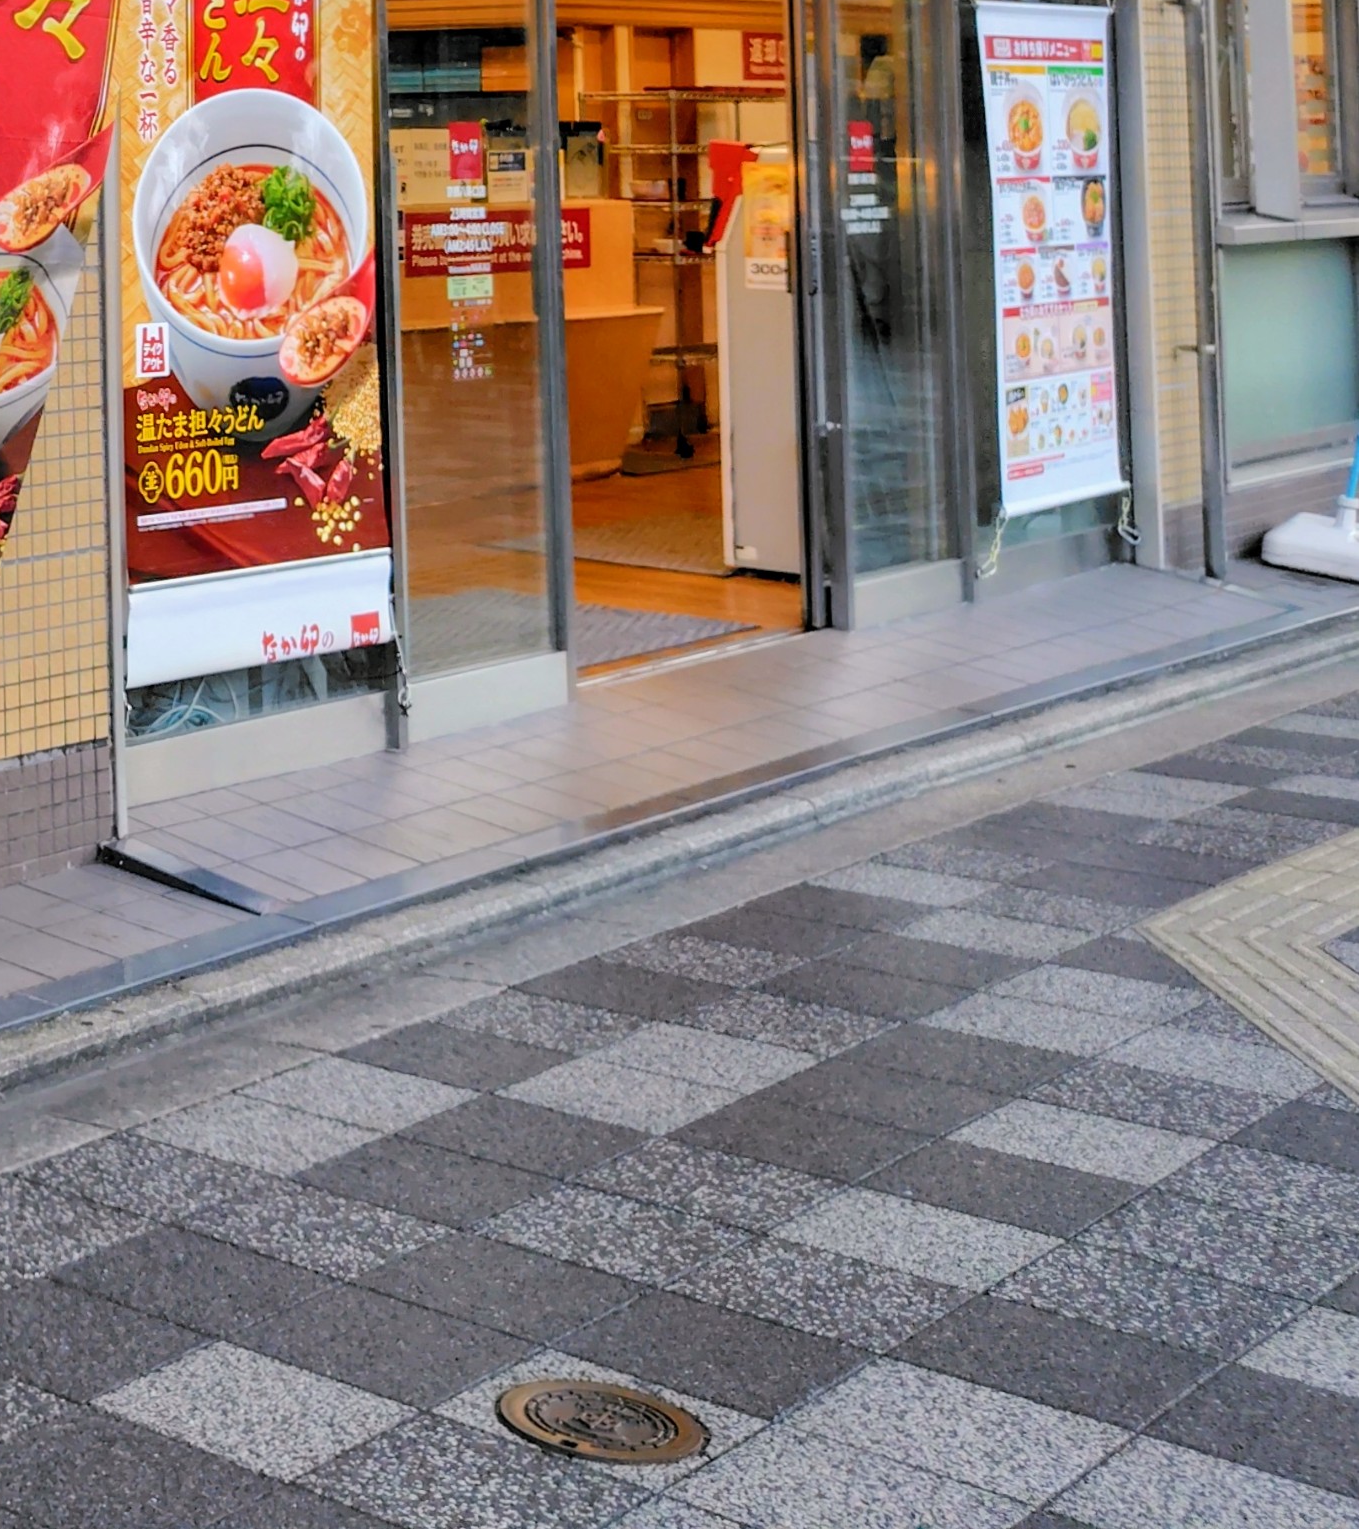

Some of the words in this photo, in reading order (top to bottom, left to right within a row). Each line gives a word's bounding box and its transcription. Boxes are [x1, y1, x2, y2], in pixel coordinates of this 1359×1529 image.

[144, 343, 163, 357] テイク
[143, 358, 164, 371] アウト
[136, 404, 265, 443] 温たま担々うどん
